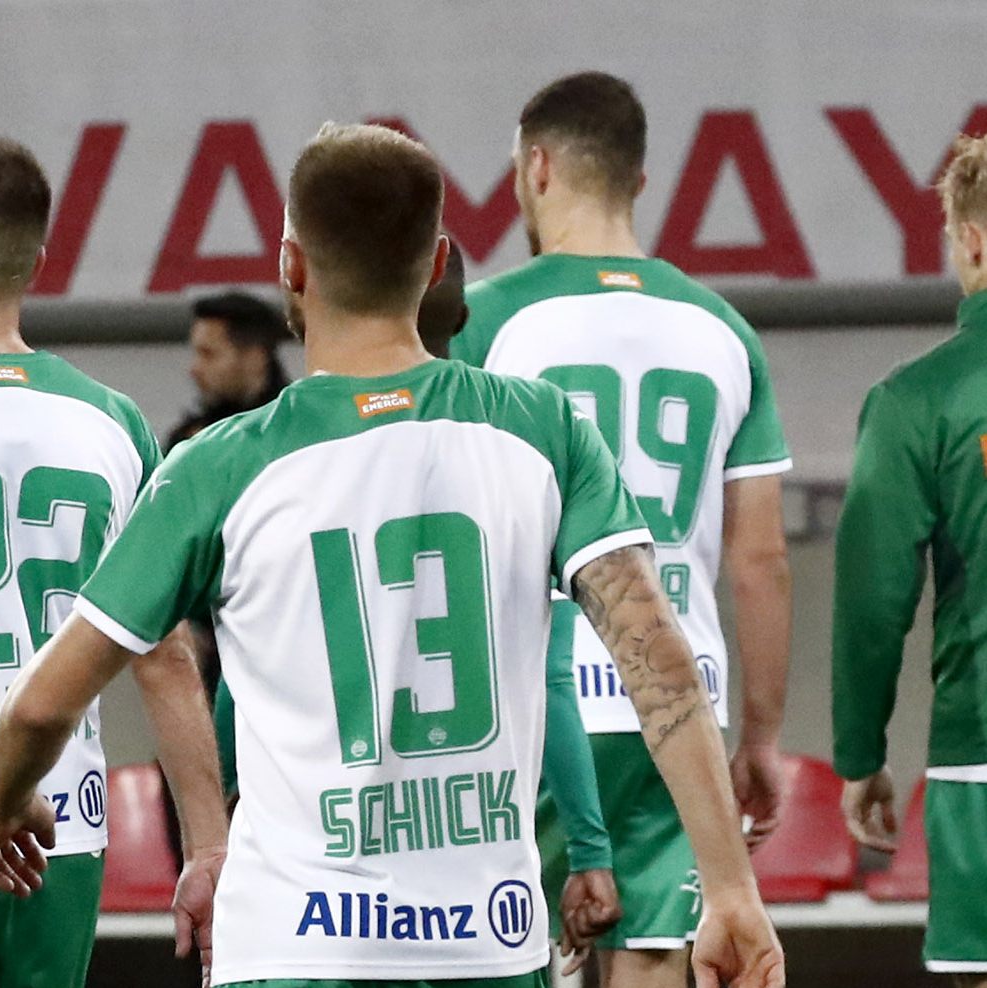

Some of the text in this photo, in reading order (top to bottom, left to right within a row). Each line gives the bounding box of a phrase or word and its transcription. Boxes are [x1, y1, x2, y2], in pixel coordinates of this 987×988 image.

[362, 397, 409, 413] ENERGIE
[310, 512, 500, 768] 13
[319, 769, 521, 858] SCHICK
[296, 891, 477, 940] Allianz
